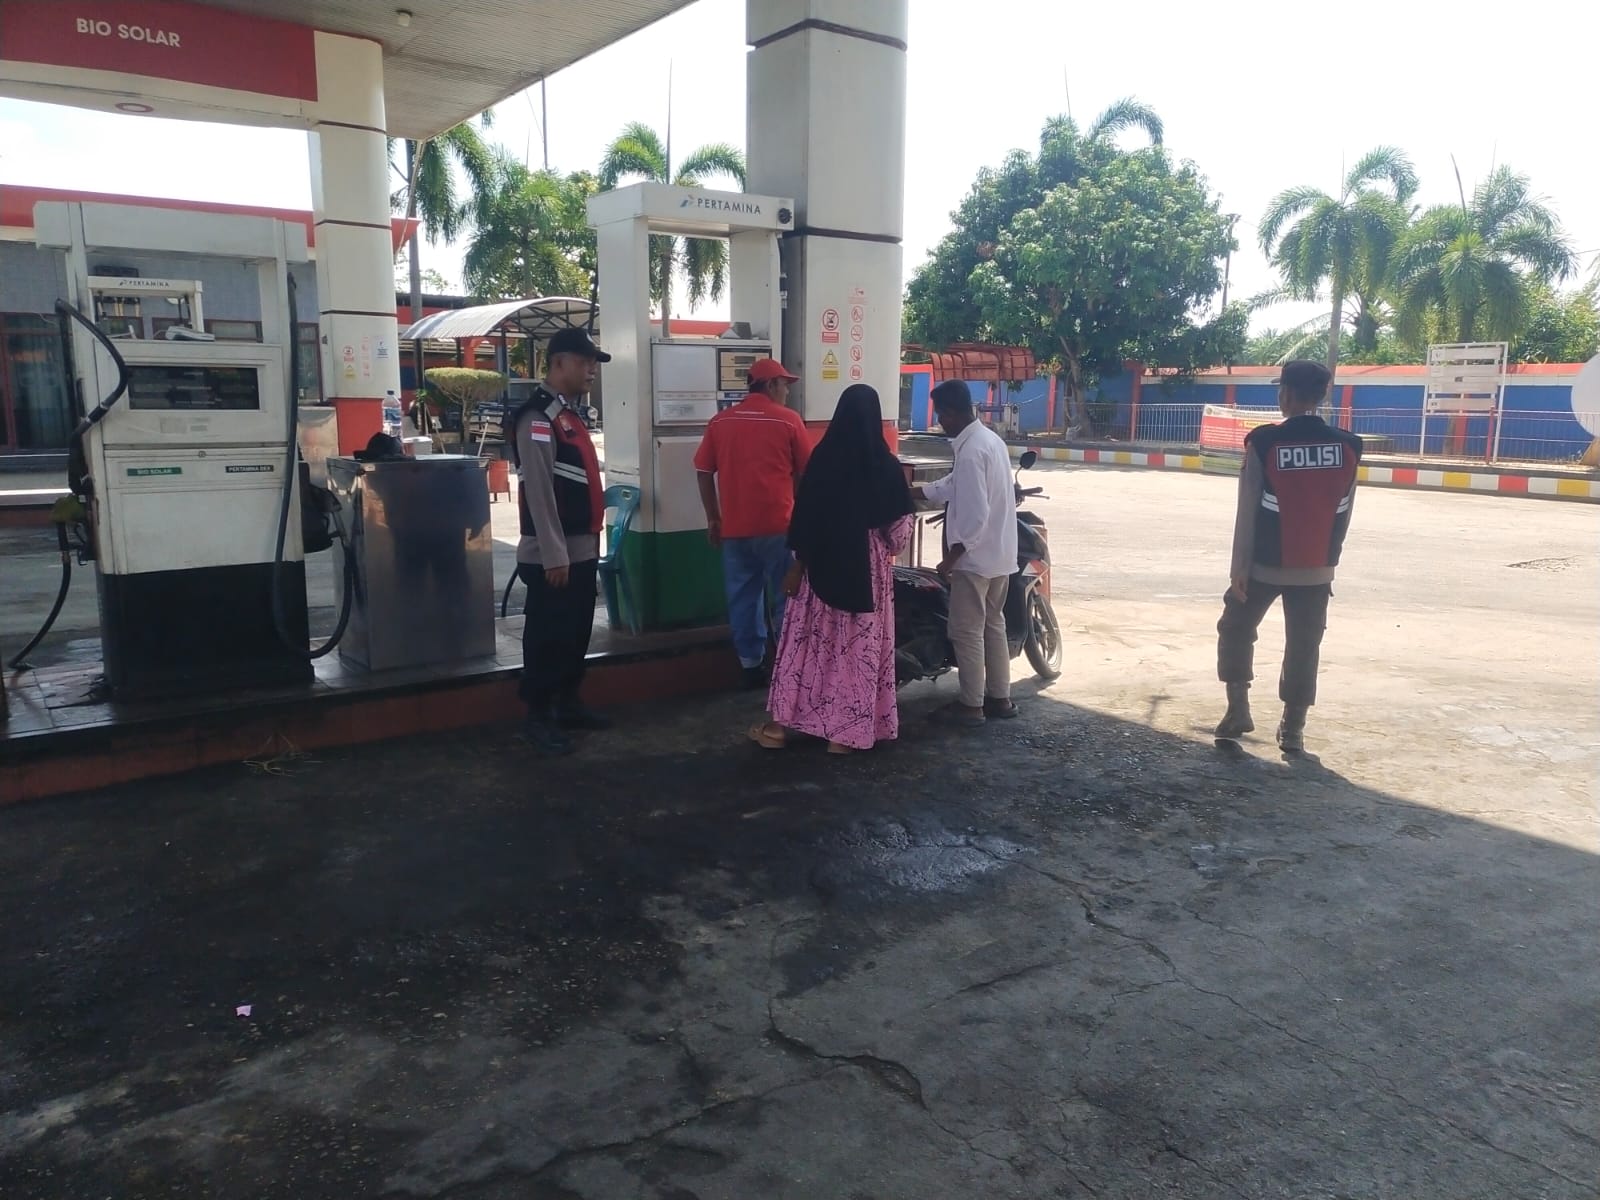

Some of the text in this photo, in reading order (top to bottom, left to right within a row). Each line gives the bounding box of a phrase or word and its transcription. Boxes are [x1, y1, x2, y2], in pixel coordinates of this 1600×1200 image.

[76, 18, 181, 47] BIO SOLAR
[697, 198, 761, 215] PERTAMINA
[1280, 446, 1340, 468] POLISI
